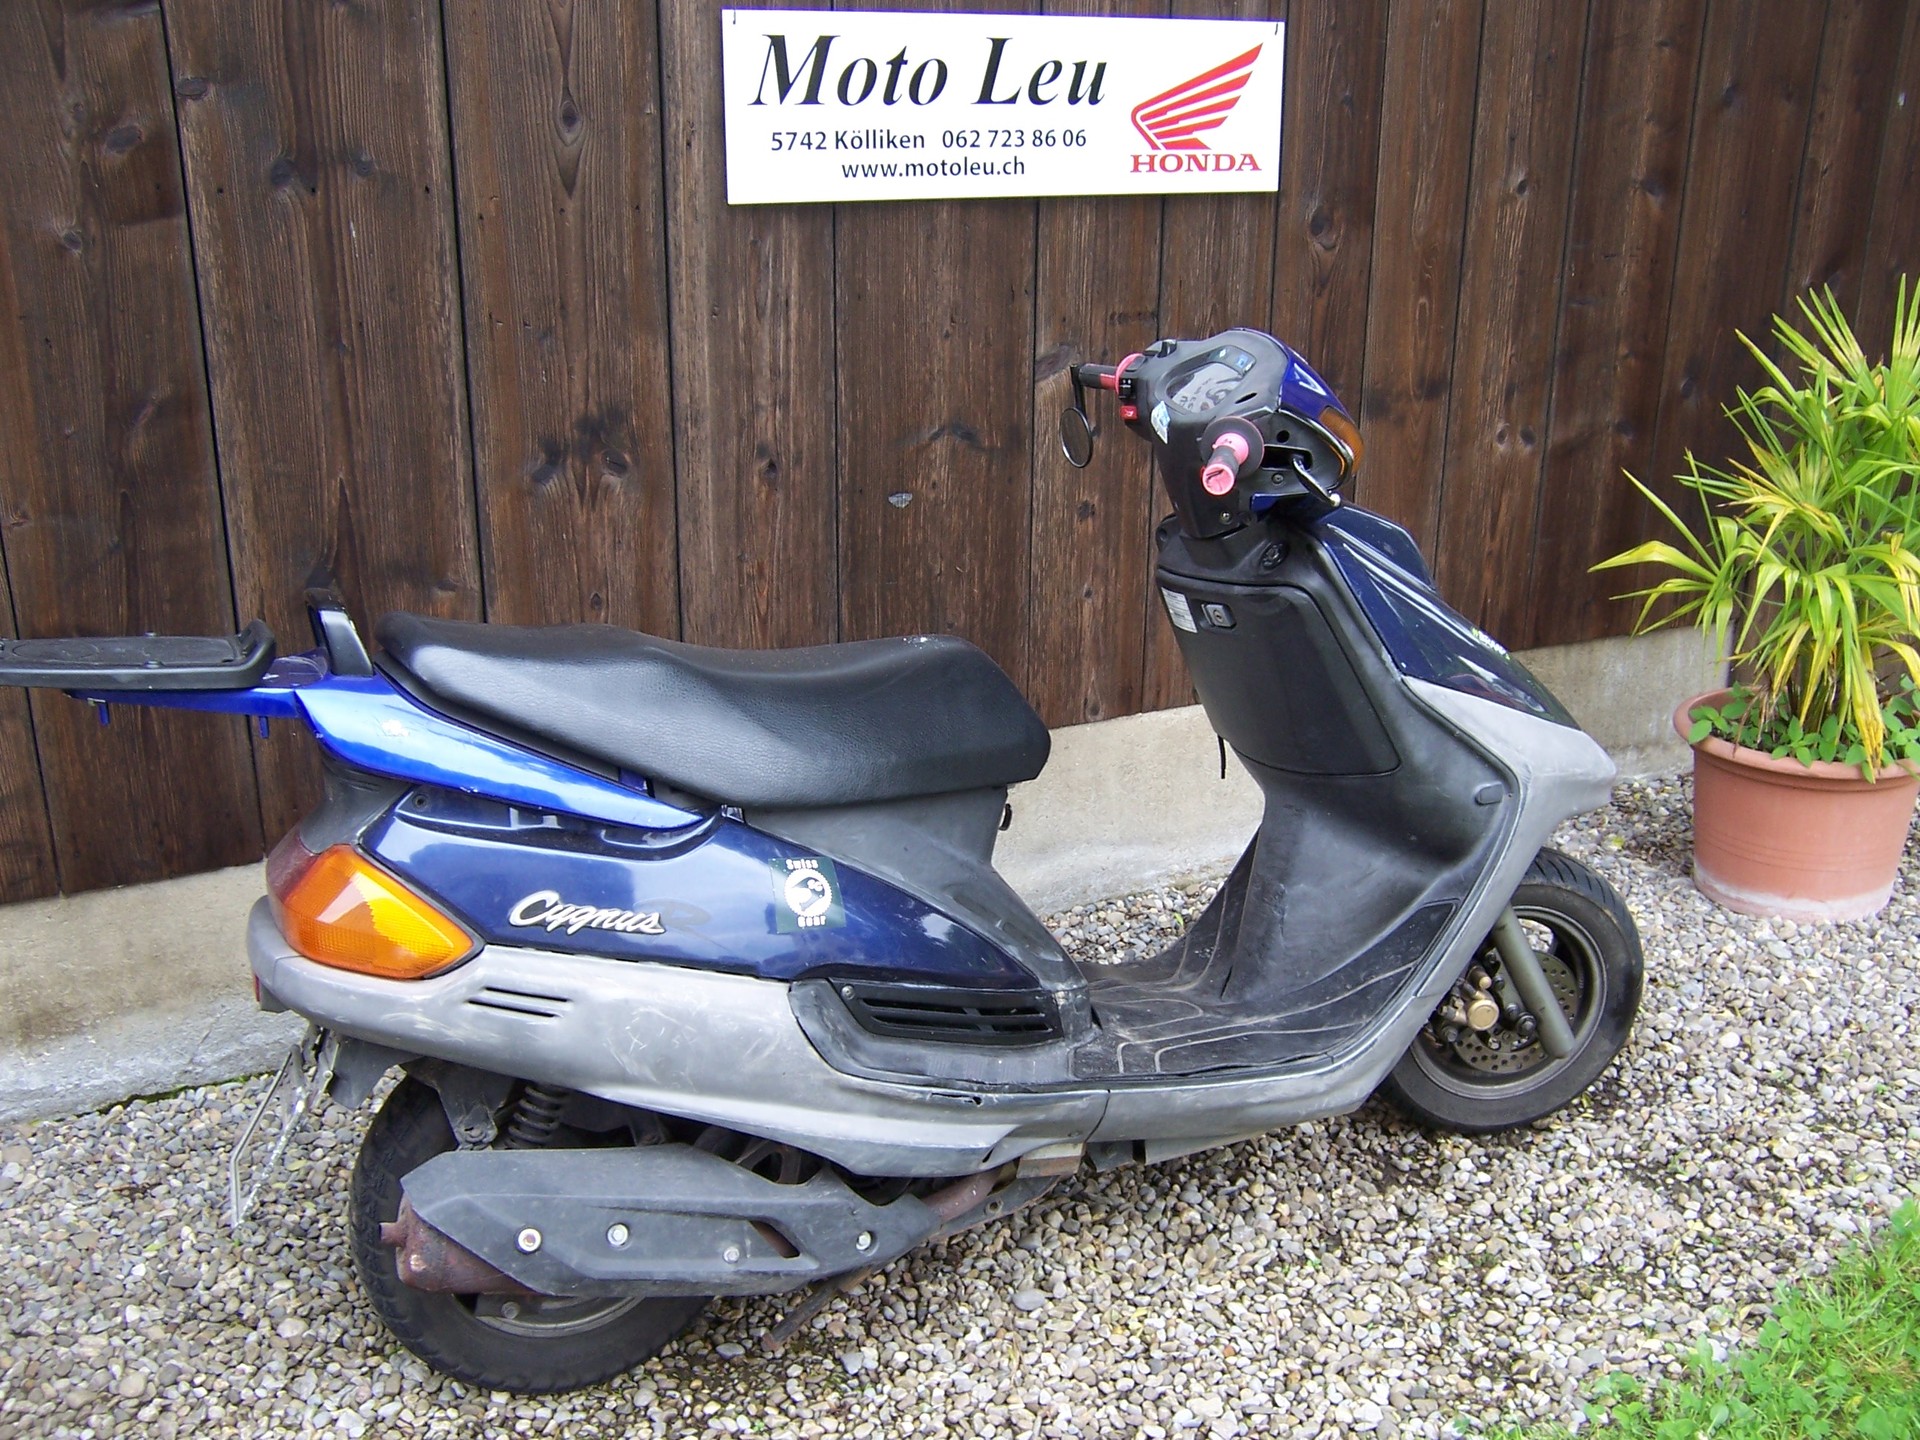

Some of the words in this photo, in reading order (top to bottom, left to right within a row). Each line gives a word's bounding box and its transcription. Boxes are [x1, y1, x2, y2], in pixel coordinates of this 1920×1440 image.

[748, 34, 948, 106] Moto
[972, 37, 1108, 106] Leu
[771, 131, 827, 151] 5742
[834, 129, 926, 150] Kölliken
[942, 129, 981, 149] 062
[988, 129, 1025, 148] 723
[1032, 129, 1057, 148] 86
[1062, 129, 1088, 147] 06
[841, 155, 1026, 178] www.motoleu.ch
[1130, 153, 1262, 173] HONDA
[508, 890, 666, 935] Cygnus
